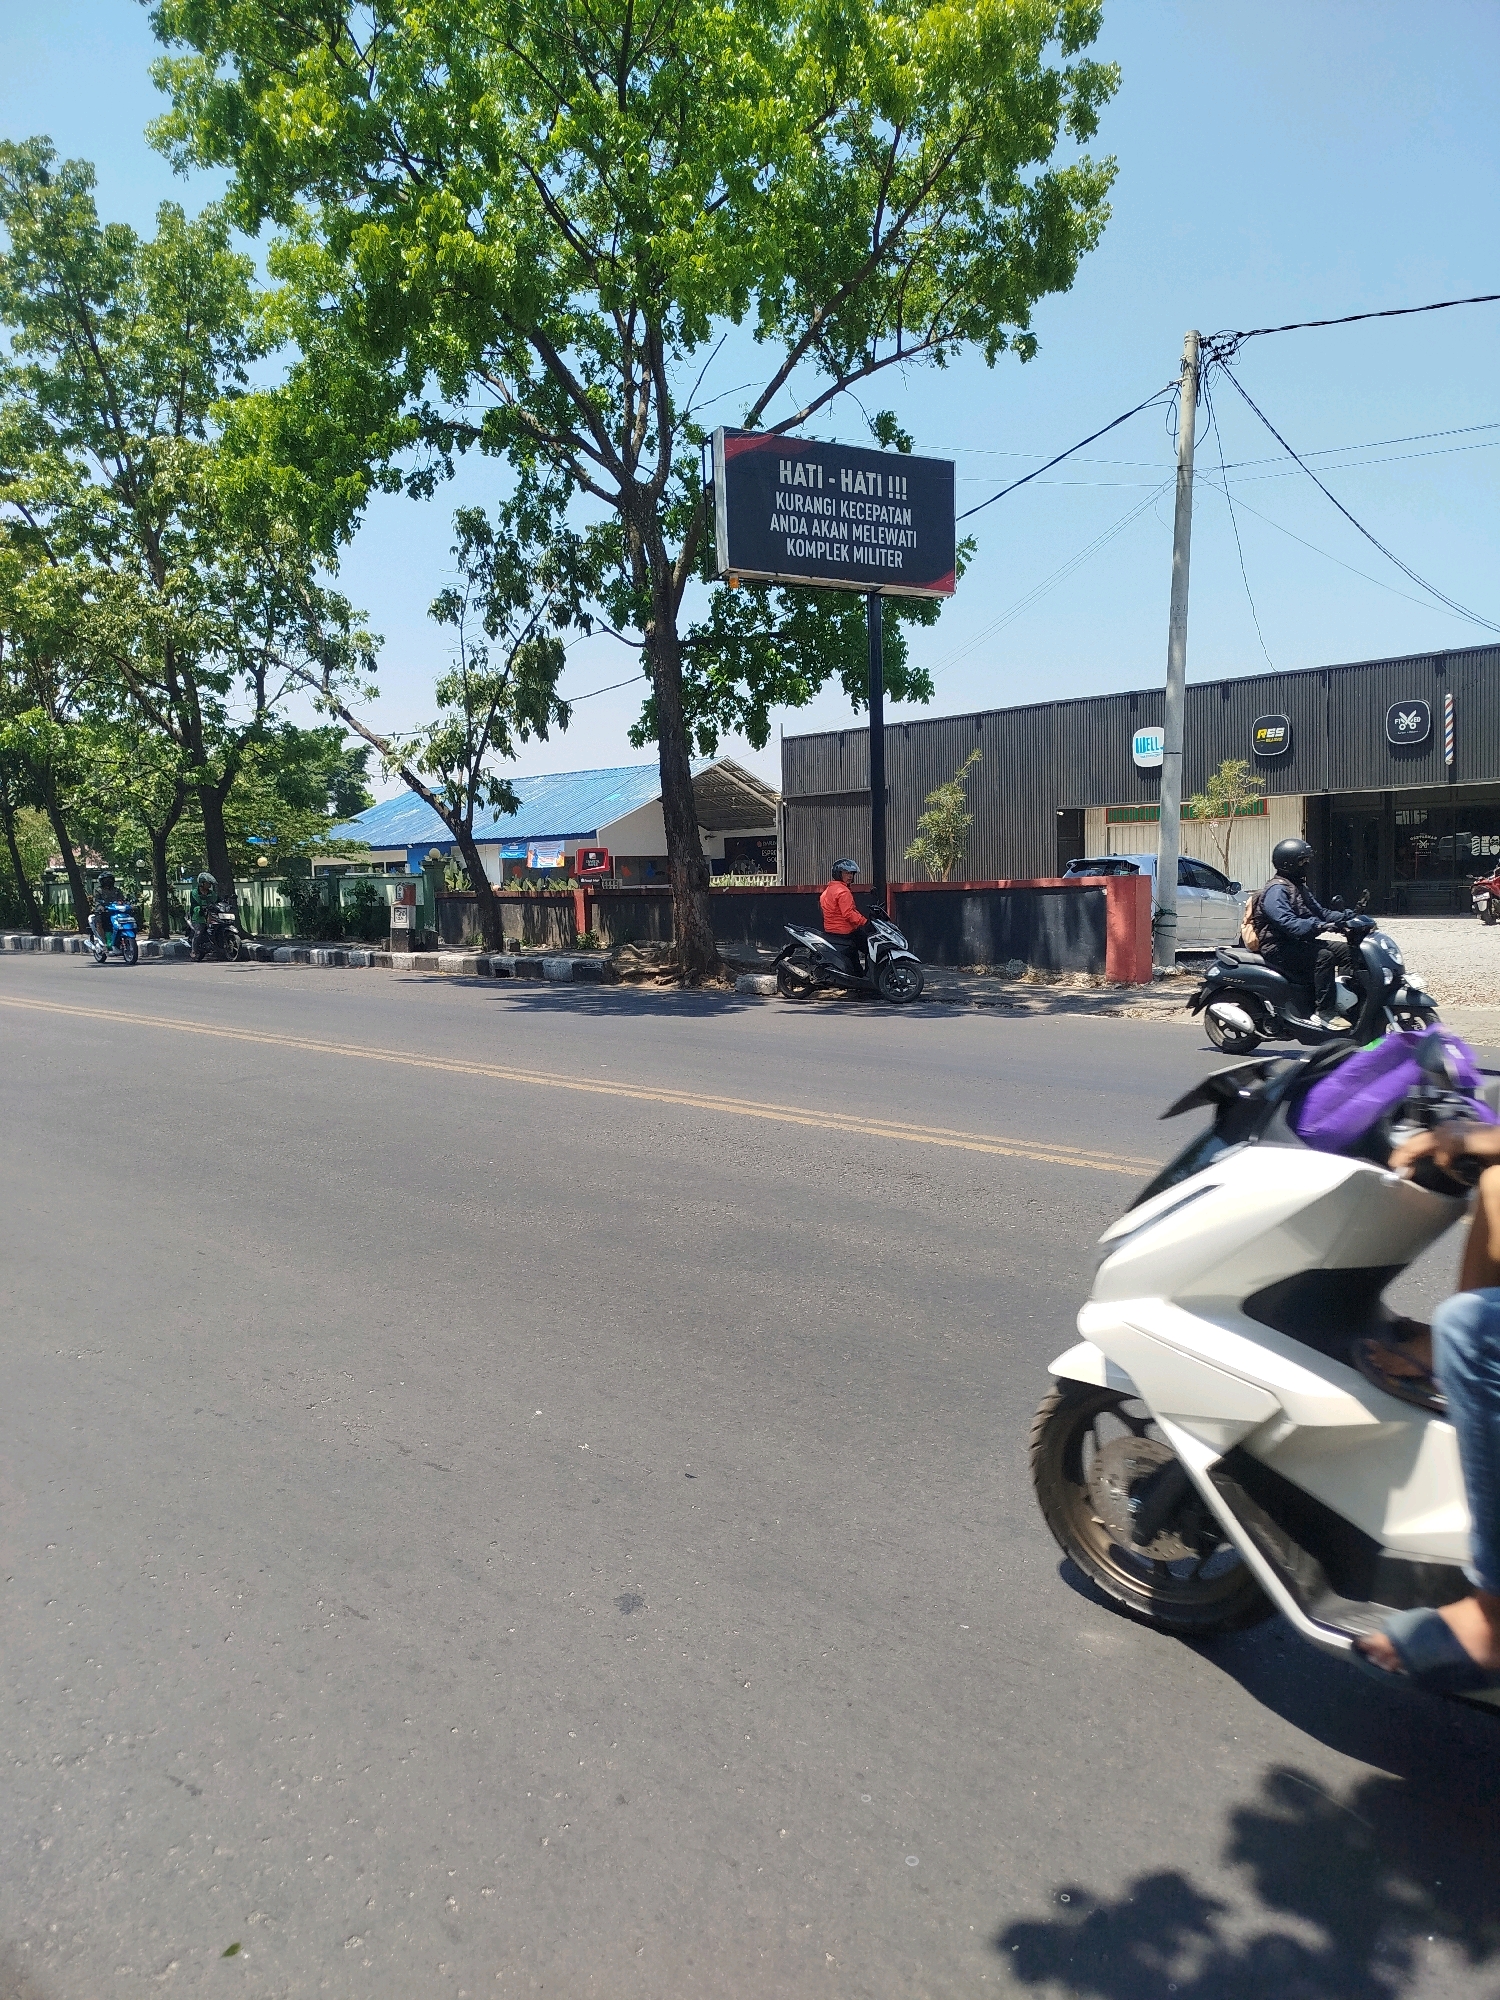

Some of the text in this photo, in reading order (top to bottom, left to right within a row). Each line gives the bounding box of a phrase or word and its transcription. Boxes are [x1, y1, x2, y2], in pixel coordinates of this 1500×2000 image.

[779, 459, 823, 489] HATI
[840, 468, 883, 497] HATI
[888, 475, 908, 501] !!!
[775, 491, 912, 527] KURANGI KECEPATAN
[769, 513, 917, 549] ANDA AKAN MELEWATI
[786, 537, 903, 569] KOMPLEK MILITER
